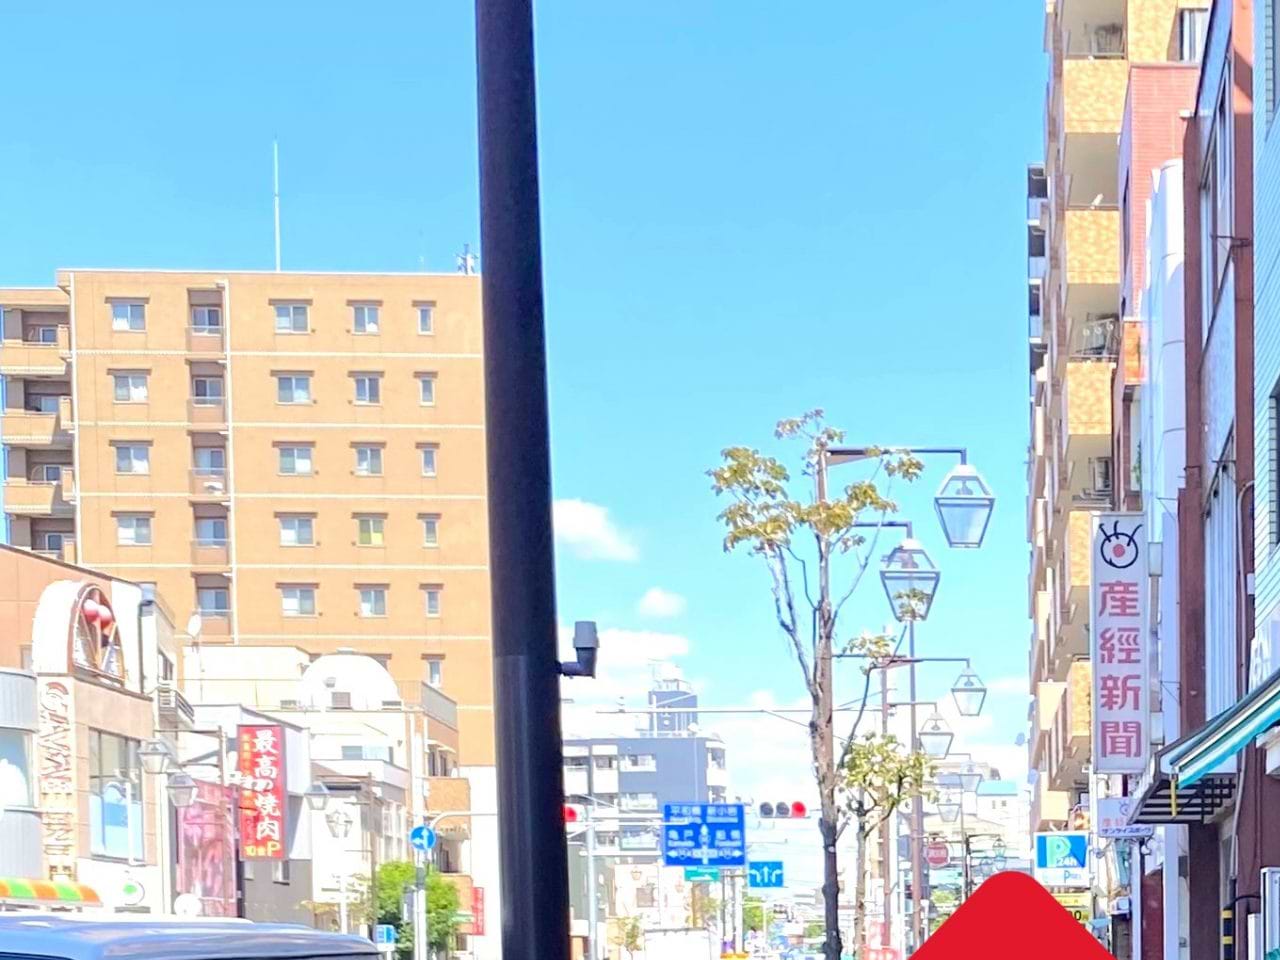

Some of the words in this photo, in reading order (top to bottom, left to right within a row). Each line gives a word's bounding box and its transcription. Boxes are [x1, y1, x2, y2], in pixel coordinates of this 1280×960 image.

[1099, 580, 1141, 758] 産經新聞
[252, 729, 280, 840] 最高の焼肉
